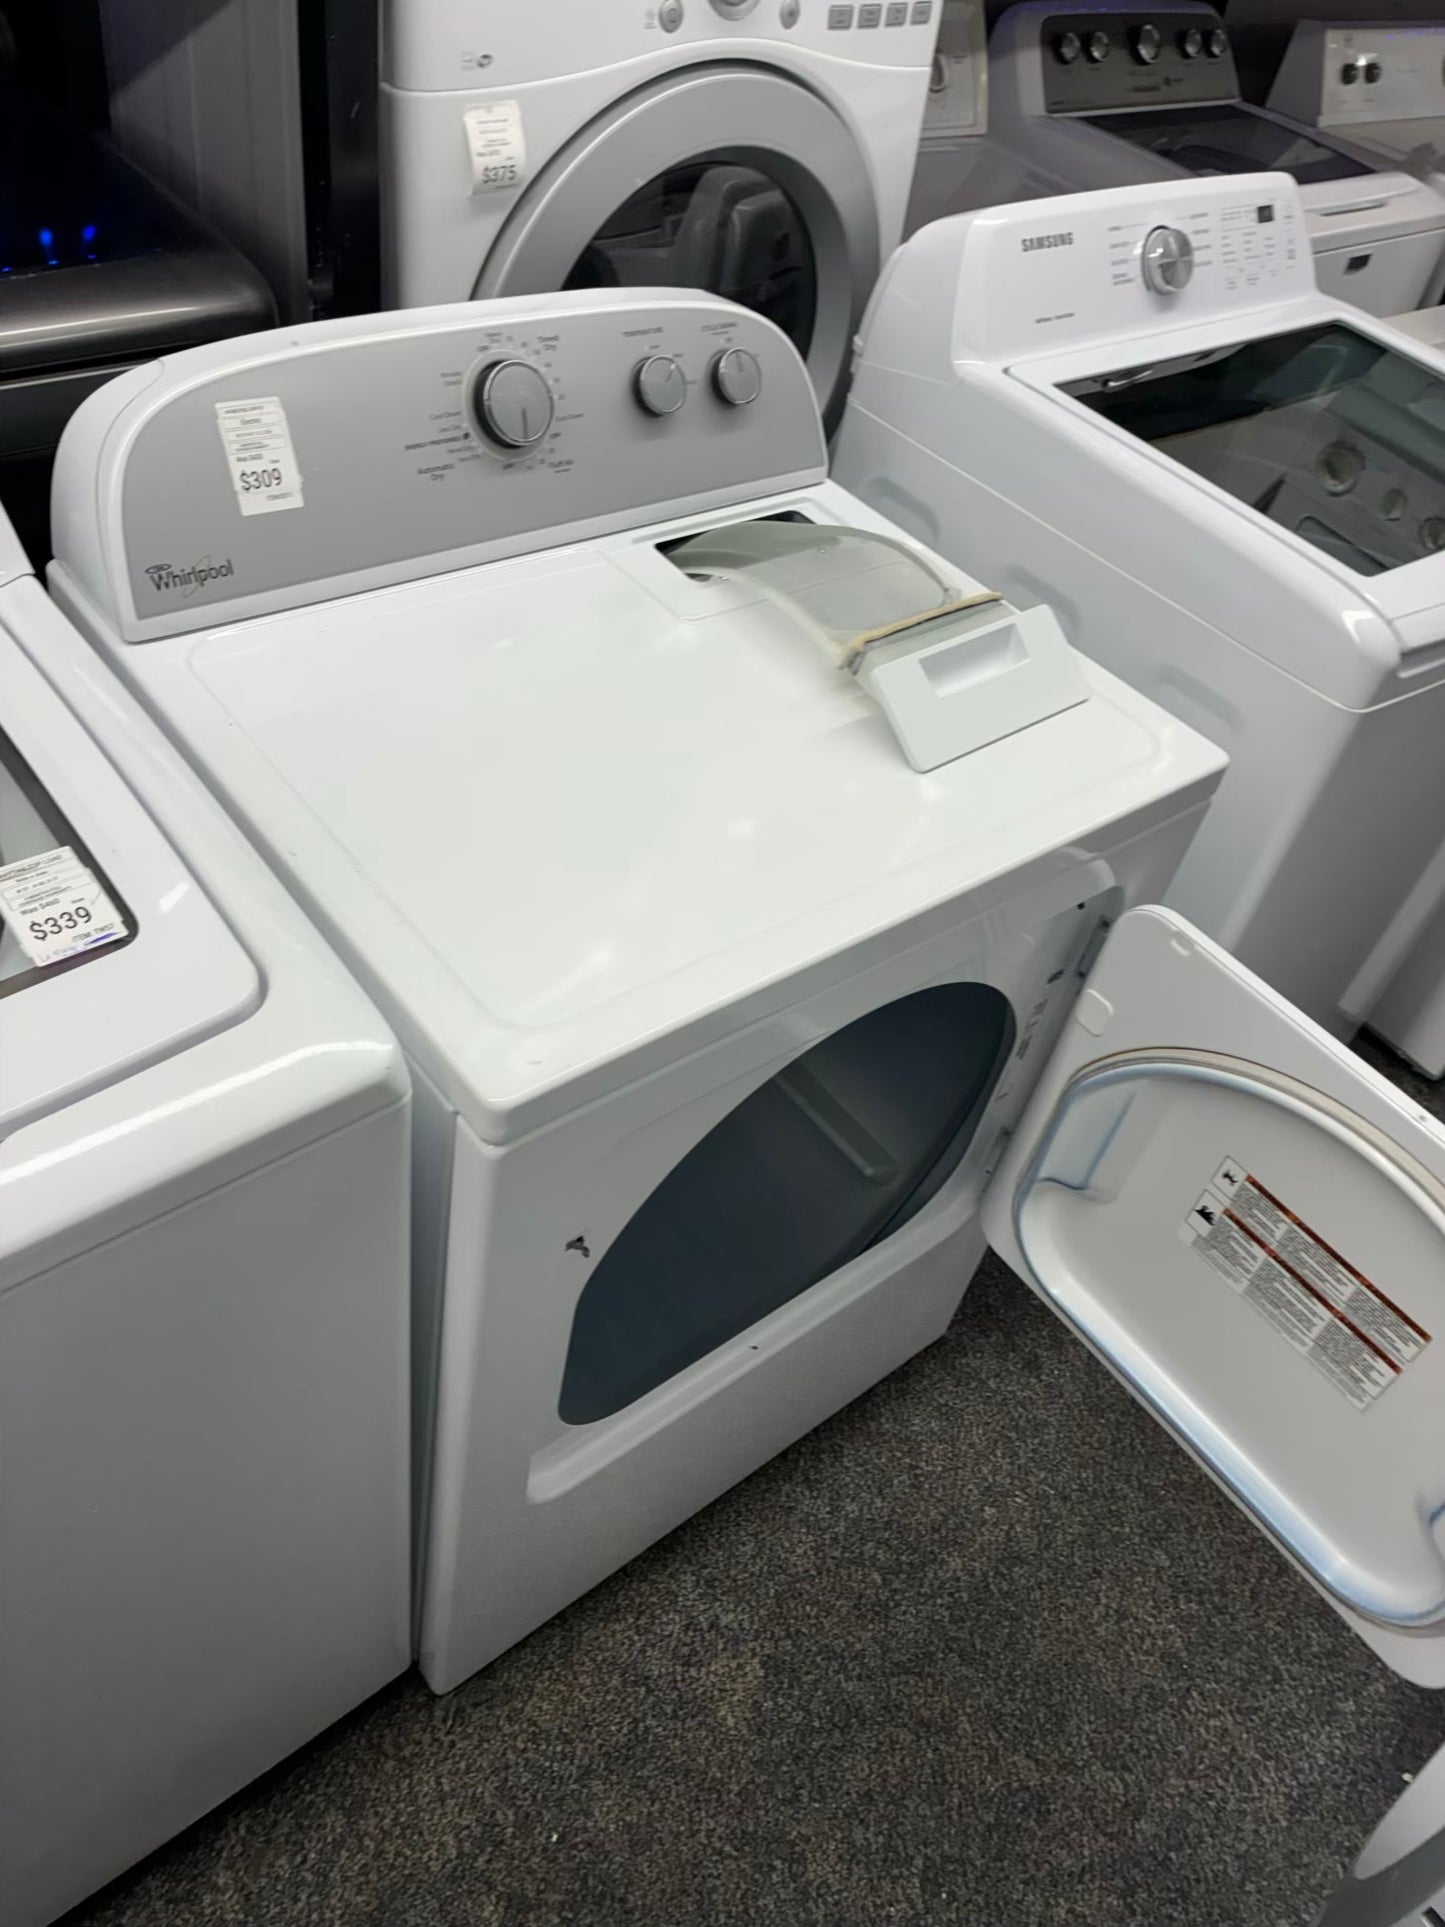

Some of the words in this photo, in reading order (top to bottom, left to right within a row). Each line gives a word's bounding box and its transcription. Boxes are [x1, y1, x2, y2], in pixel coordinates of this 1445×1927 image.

[1021, 231, 1074, 252] SAMSUNG
[240, 467, 283, 493] $309
[147, 558, 235, 592] Whirlpool
[29, 906, 92, 942] $339
